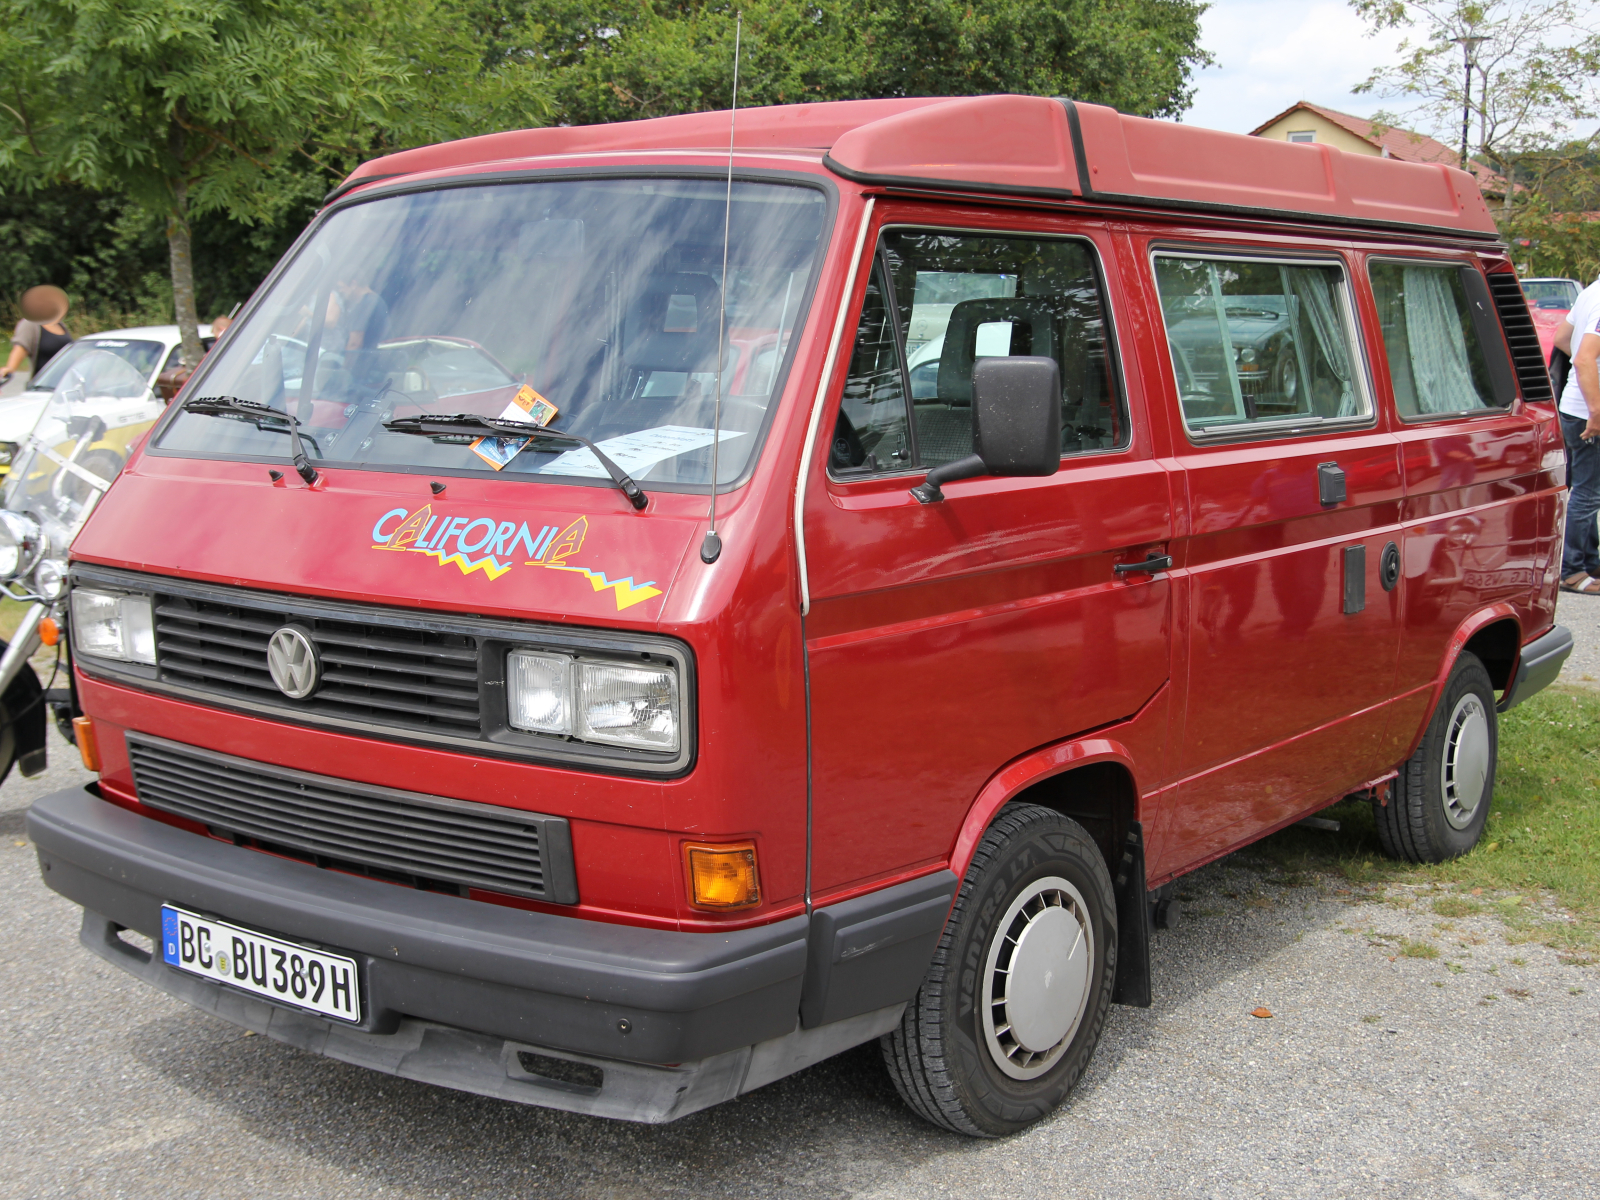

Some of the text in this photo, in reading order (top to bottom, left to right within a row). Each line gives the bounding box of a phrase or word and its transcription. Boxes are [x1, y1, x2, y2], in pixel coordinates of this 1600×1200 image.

[371, 503, 588, 566] CALIFORNIA
[1011, 848, 1033, 878] LT
[168, 942, 176, 956] D
[180, 919, 213, 970] BC
